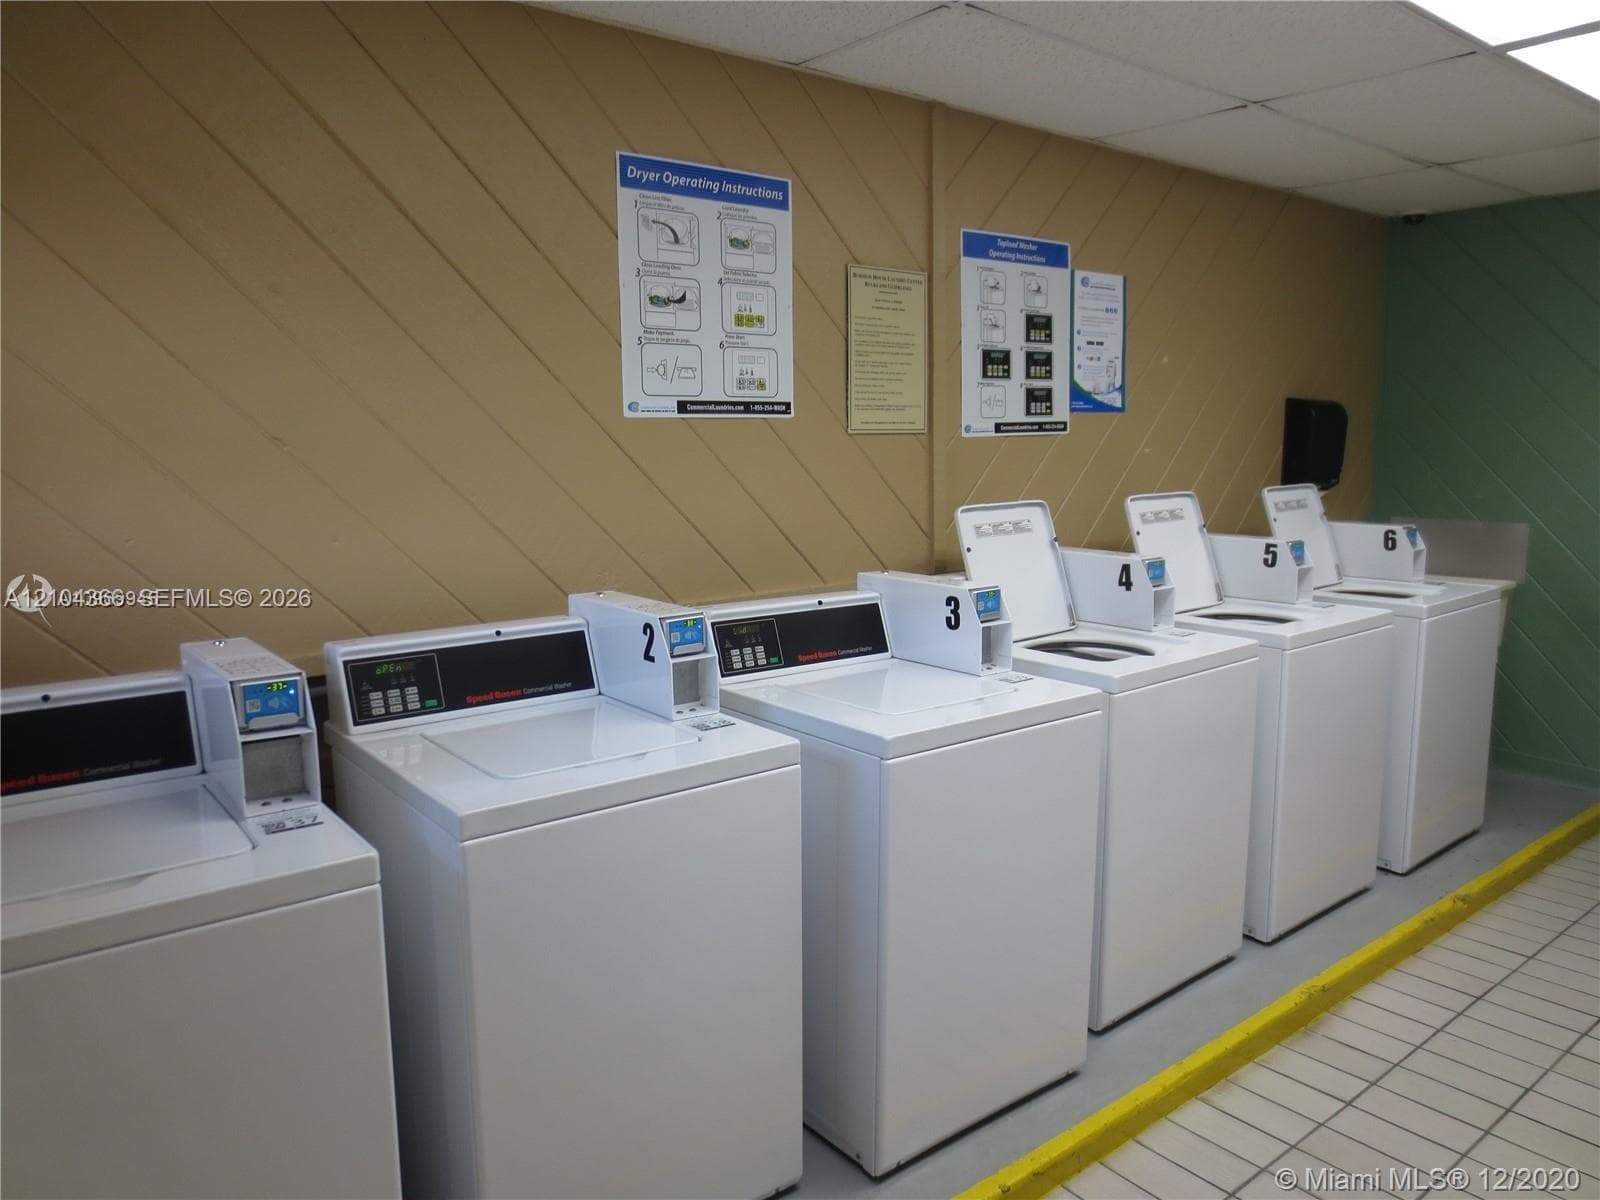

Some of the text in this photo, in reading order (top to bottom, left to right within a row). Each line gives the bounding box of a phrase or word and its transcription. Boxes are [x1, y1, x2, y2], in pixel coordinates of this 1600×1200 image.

[627, 165, 784, 200] Dryer Operating Instructions
[997, 238, 1038, 251] Topload Washer
[988, 249, 1046, 264] Operating Instructions
[635, 267, 641, 277] 3
[637, 336, 643, 346] 5
[719, 340, 725, 350] 6
[1383, 529, 1397, 551] 6
[1263, 543, 1278, 568] 5
[1118, 563, 1133, 592] 4
[945, 596, 960, 630] 3
[643, 623, 655, 663] 2
[466, 681, 572, 704] Speed Queen Commercial Washer
